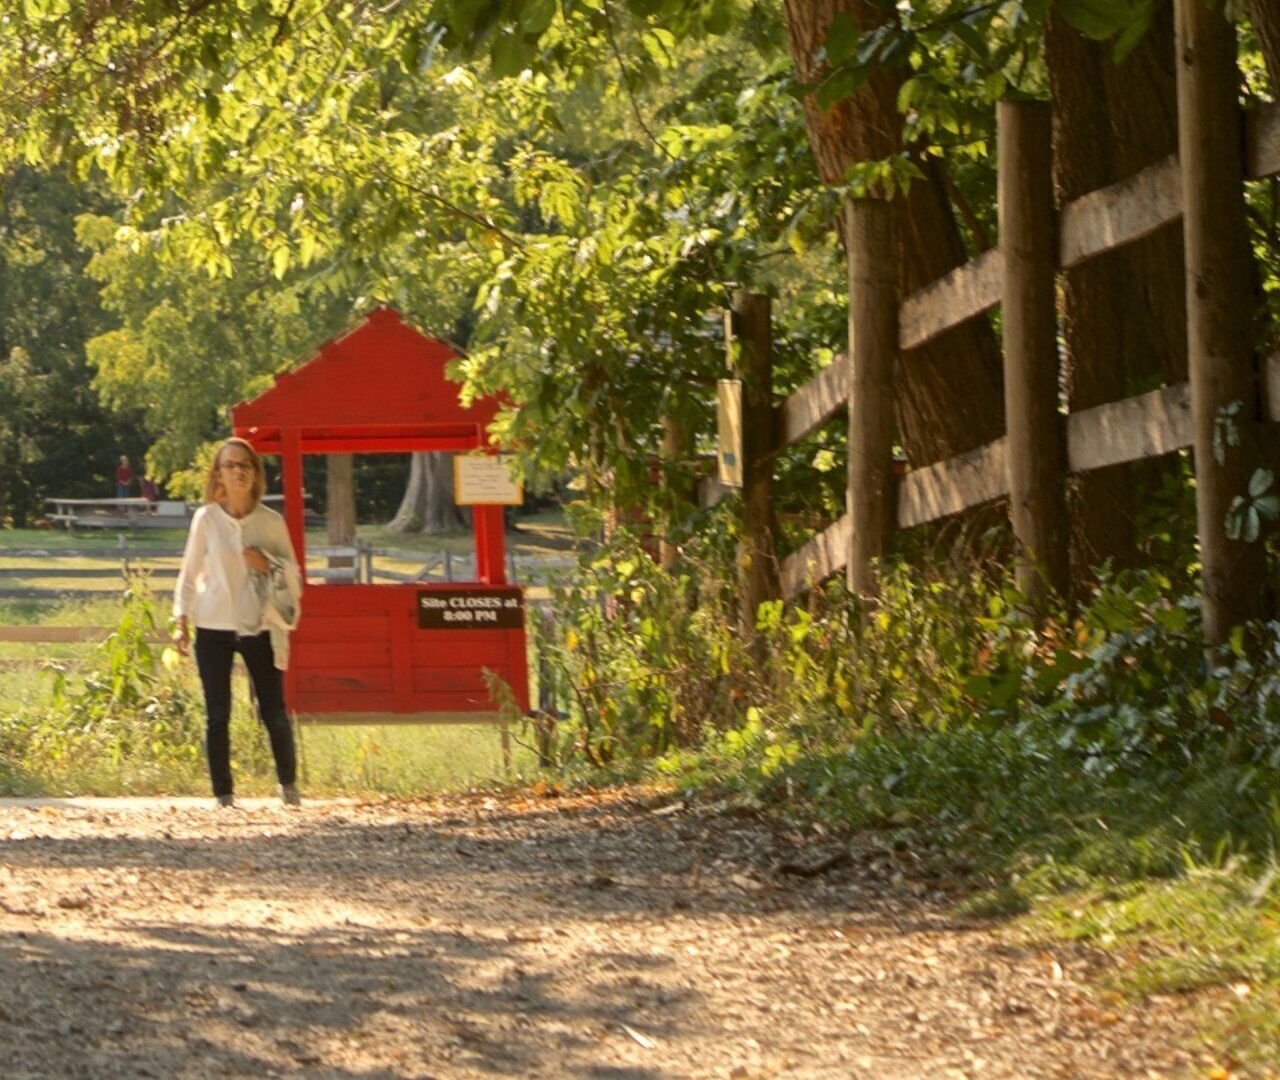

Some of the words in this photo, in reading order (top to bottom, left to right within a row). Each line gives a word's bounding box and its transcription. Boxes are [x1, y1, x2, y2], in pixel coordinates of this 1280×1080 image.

[421, 597, 448, 608] Site
[448, 597, 502, 608] CLOSES
[503, 597, 518, 608] at
[474, 610, 497, 621] PM
